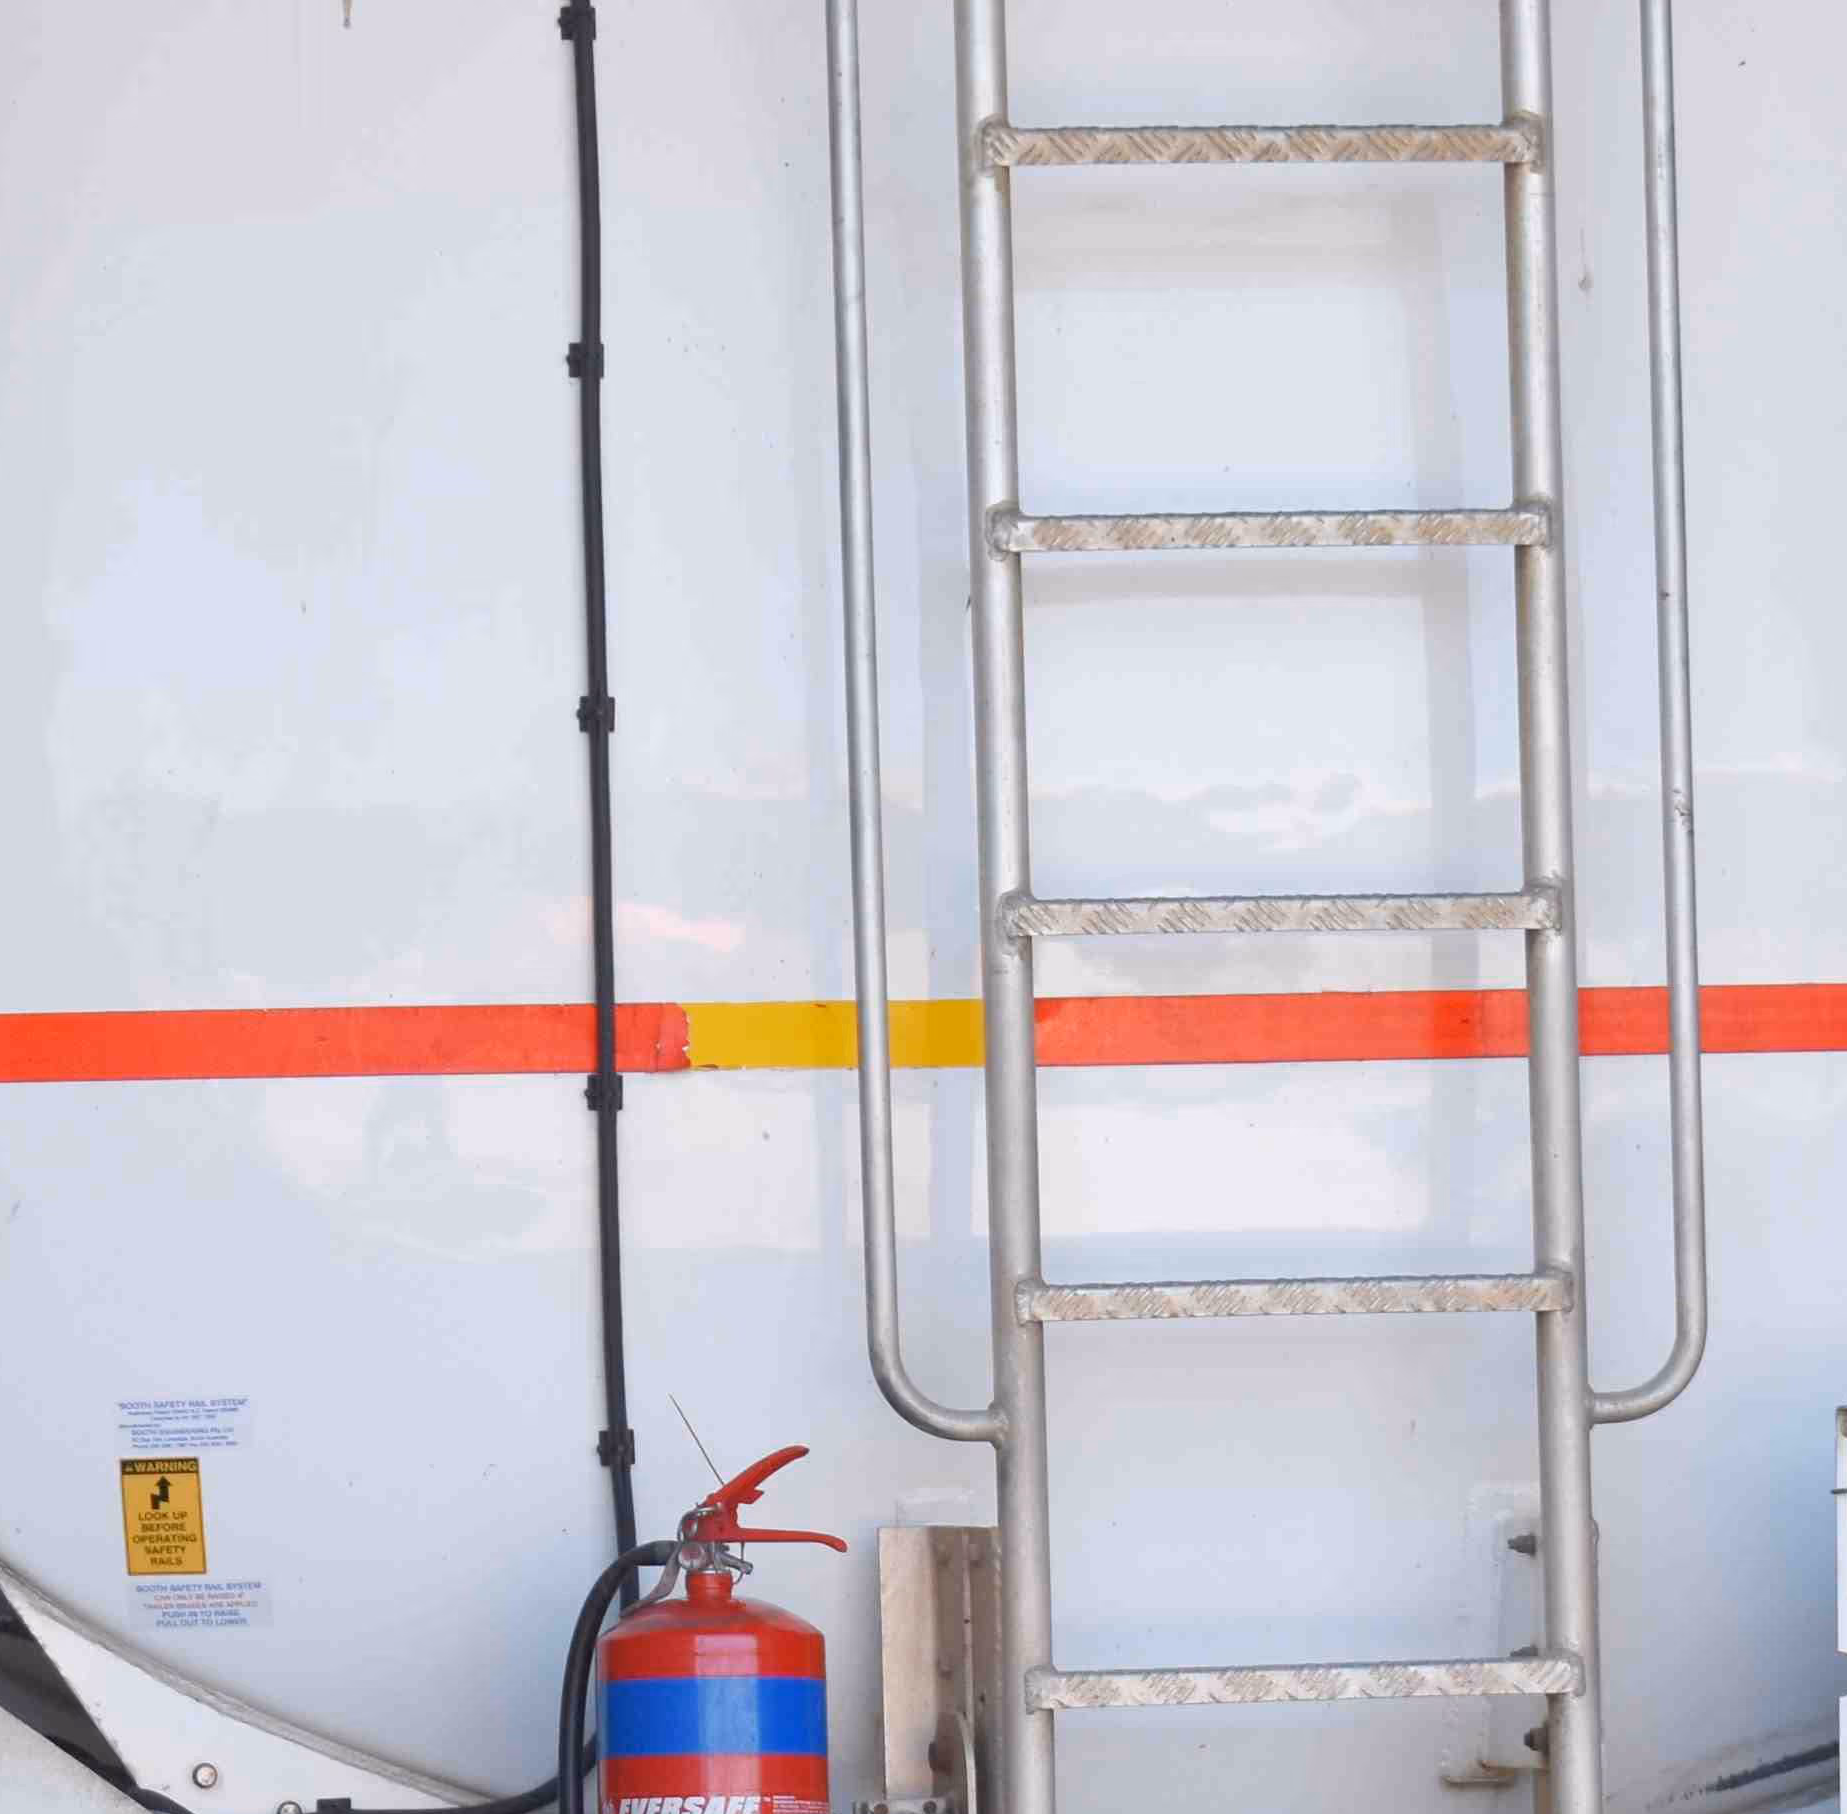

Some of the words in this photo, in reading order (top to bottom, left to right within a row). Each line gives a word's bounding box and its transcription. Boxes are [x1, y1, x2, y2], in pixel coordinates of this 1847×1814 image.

[135, 1462, 196, 1472] WARNING
[139, 1512, 168, 1521] LOOK
[173, 1512, 187, 1520] UP
[141, 1523, 185, 1532] BEFORE
[133, 1534, 197, 1544] OPERATING
[145, 1546, 185, 1554] SAFETY
[150, 1557, 182, 1565] RAILS
